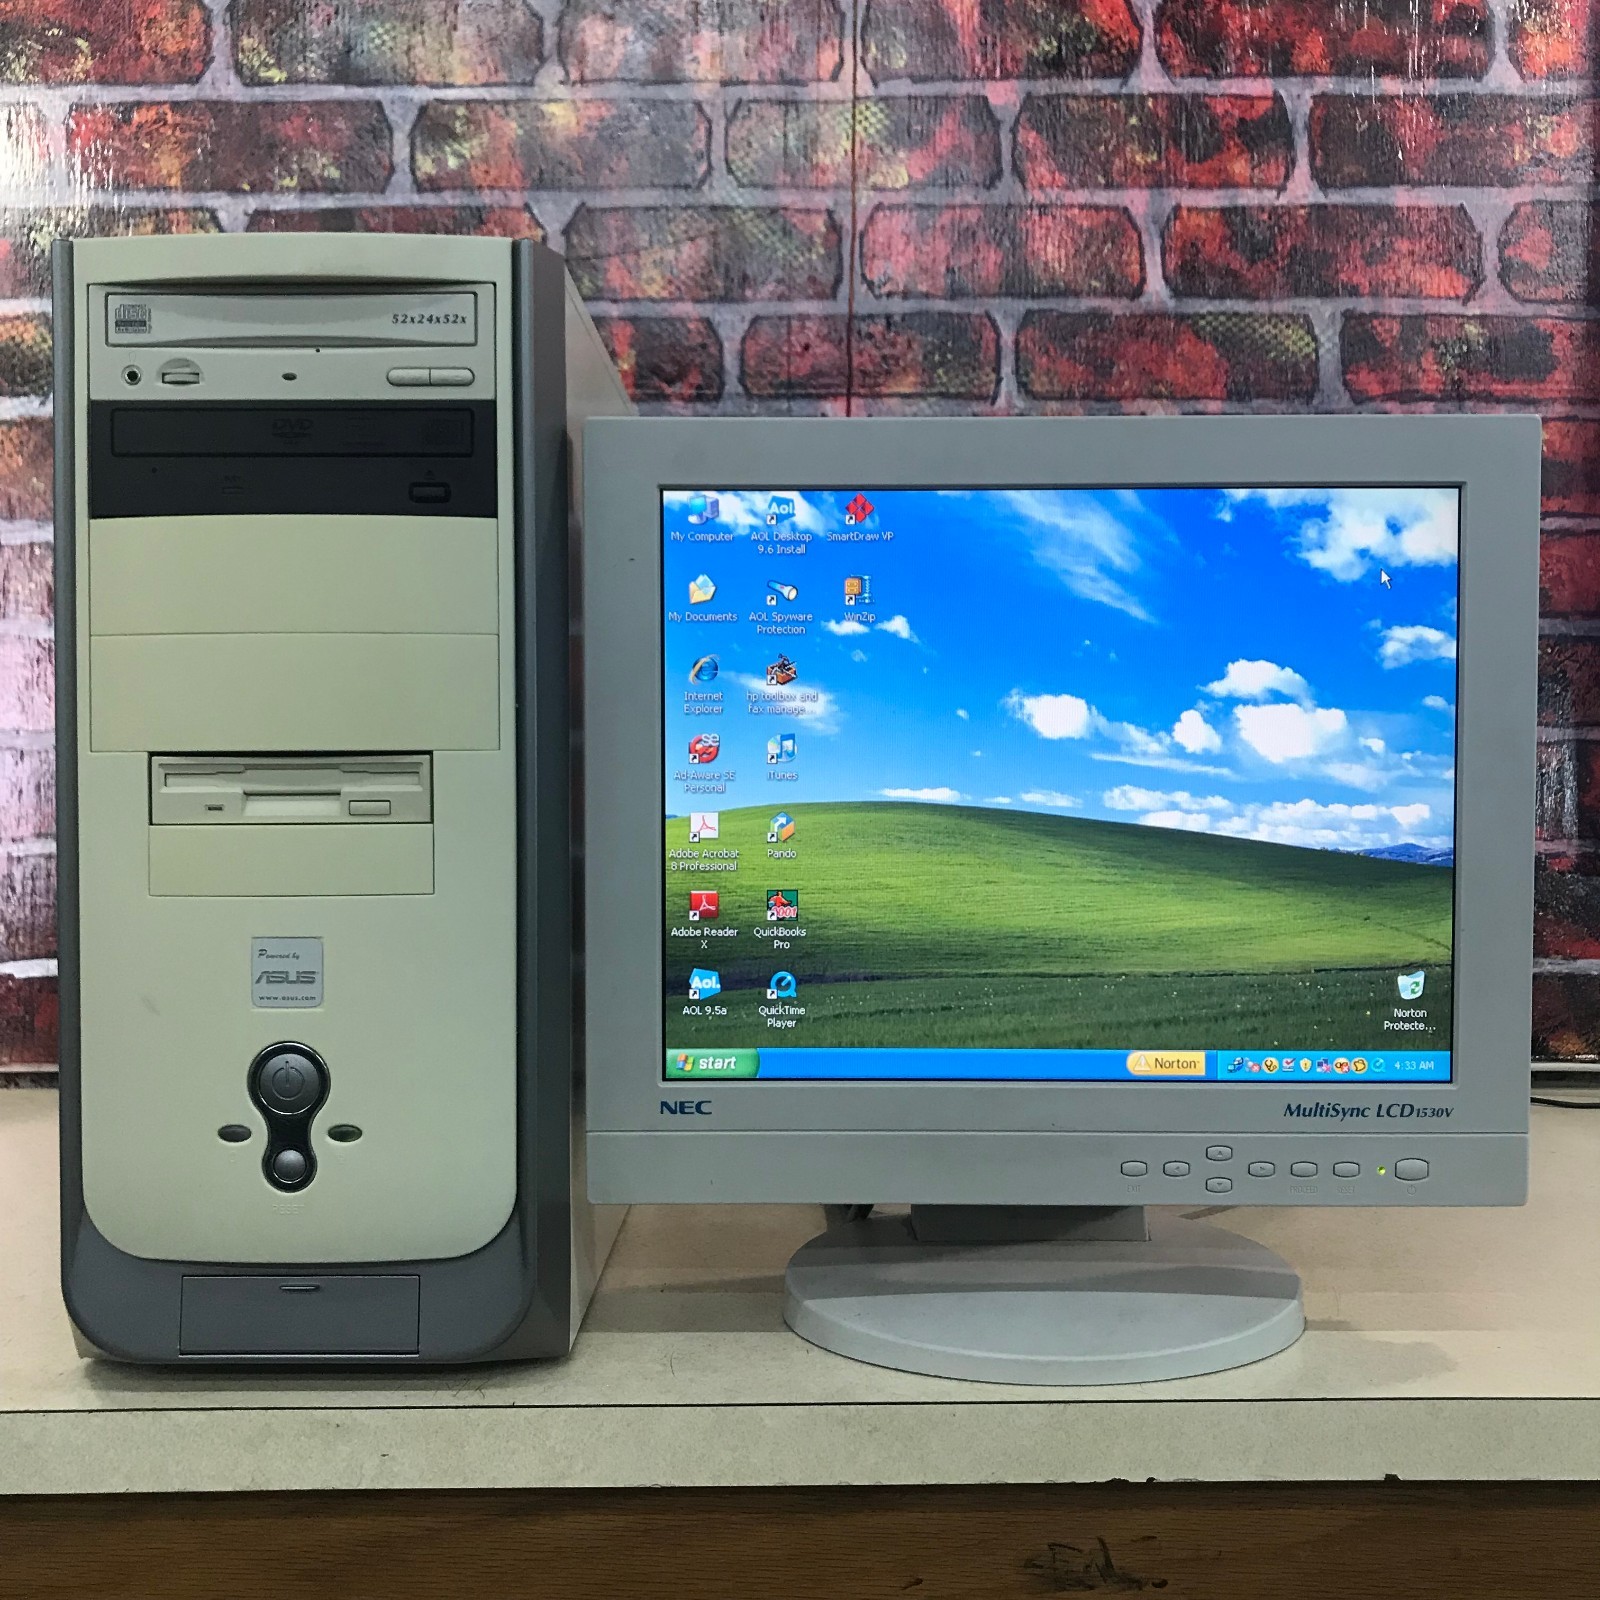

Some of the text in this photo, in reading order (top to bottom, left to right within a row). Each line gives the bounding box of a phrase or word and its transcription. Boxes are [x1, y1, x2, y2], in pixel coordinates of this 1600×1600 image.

[391, 313, 468, 324] 52x24x52x
[671, 532, 733, 543] My Computer
[750, 532, 812, 543] AOL Desktop
[826, 532, 894, 541] SmartDraw VP
[757, 545, 806, 554] 9.6 Install
[669, 612, 738, 622] My Documents
[749, 612, 813, 623] AOL Spyware
[844, 612, 876, 623] WinZip
[757, 625, 806, 635] Protection
[684, 692, 723, 701] Internet
[746, 692, 818, 703] hp toolbox and
[684, 704, 723, 715] Explorer
[748, 704, 764, 713] fax
[674, 771, 736, 780] Ad-Aware SE
[767, 771, 798, 780] iTunes
[684, 783, 726, 792] Personal
[669, 849, 739, 858] Adobe Acrobat
[767, 849, 796, 858] Pando
[671, 862, 737, 871] 8 Professional
[671, 928, 739, 937] Adobe Reader
[753, 928, 807, 938] QuickBooks
[701, 940, 708, 949] X
[773, 940, 790, 949] Pro
[258, 948, 300, 961] Powered by
[255, 970, 317, 985] ASUS
[682, 1006, 728, 1015] AOL 9.5a
[758, 1006, 806, 1016] QuickTime
[1393, 1008, 1427, 1018] Norton
[767, 1019, 797, 1029] Player
[699, 1056, 737, 1070] start
[1154, 1057, 1198, 1070] Norton
[1394, 1060, 1435, 1070] 4:33 AM
[660, 1101, 712, 1115] NEC
[1283, 1102, 1370, 1122] MultiSync
[1126, 1185, 1141, 1193] EXIT
